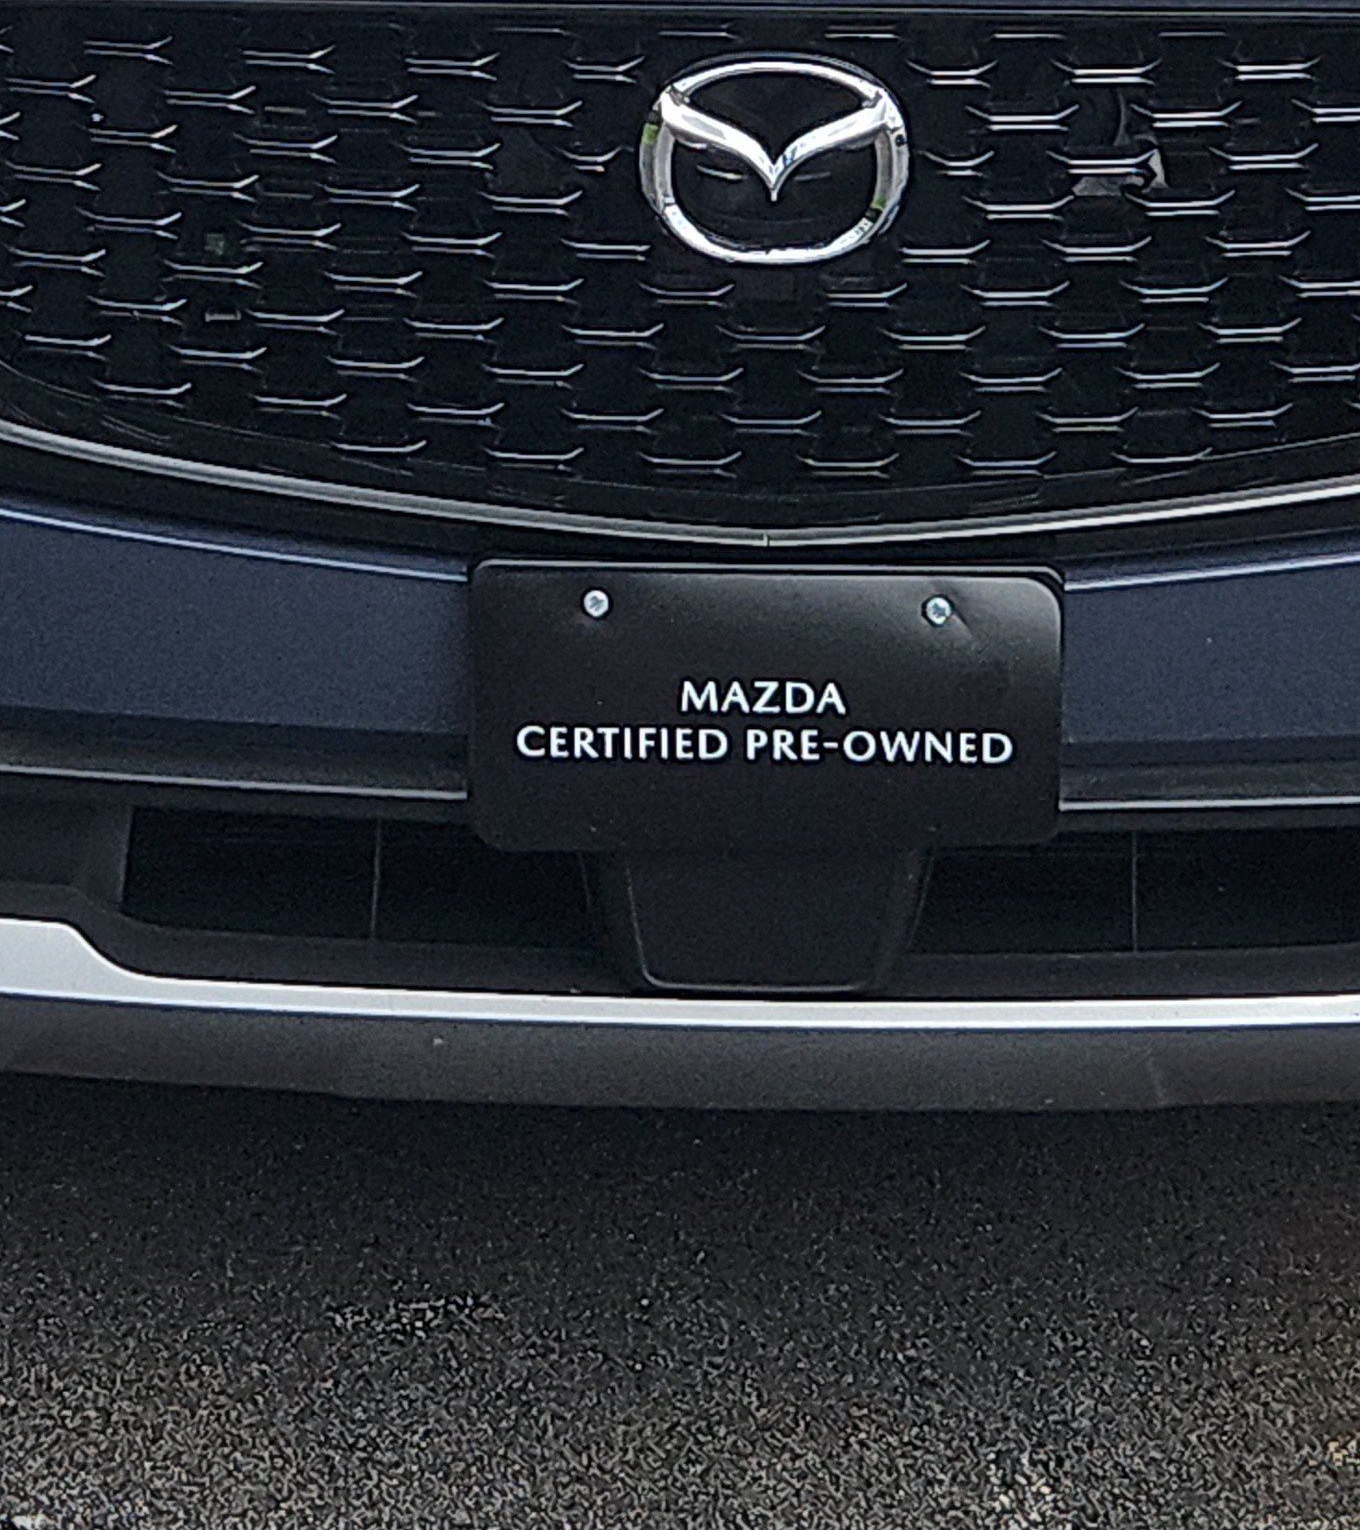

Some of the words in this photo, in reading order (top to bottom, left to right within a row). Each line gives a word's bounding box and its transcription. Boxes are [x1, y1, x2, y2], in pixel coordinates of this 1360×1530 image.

[680, 680, 846, 715] MAZDA
[515, 725, 729, 761] CERTIFIED
[746, 728, 1014, 765] PRE-OWNED
